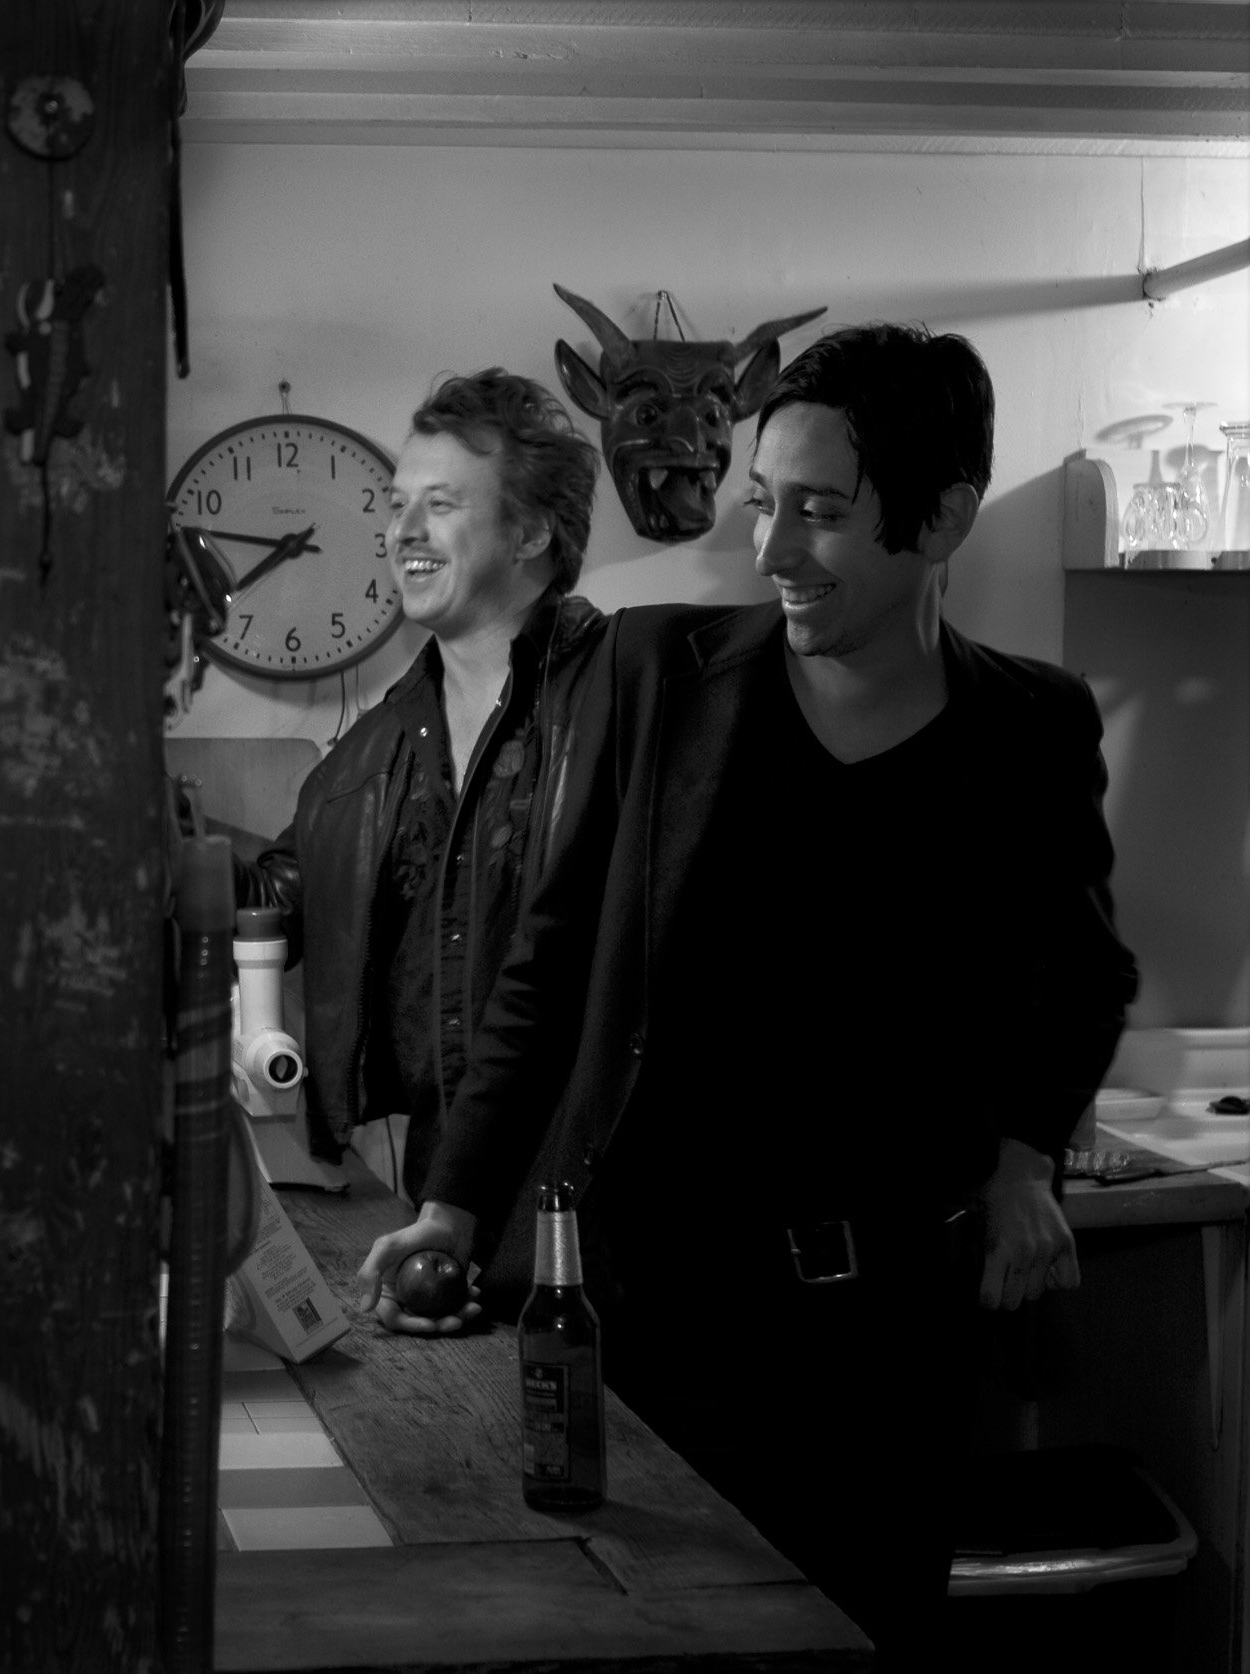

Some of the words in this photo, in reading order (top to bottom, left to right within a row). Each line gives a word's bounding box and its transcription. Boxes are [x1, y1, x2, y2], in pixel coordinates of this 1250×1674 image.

[233, 455, 252, 481] 11
[276, 442, 299, 468] 12
[330, 455, 336, 480] 1
[197, 489, 223, 516] 10
[361, 488, 376, 513] 2
[374, 533, 388, 558] 3
[364, 579, 379, 604] 4
[239, 614, 254, 641] 7
[331, 613, 346, 639] 5
[285, 627, 302, 653] 6
